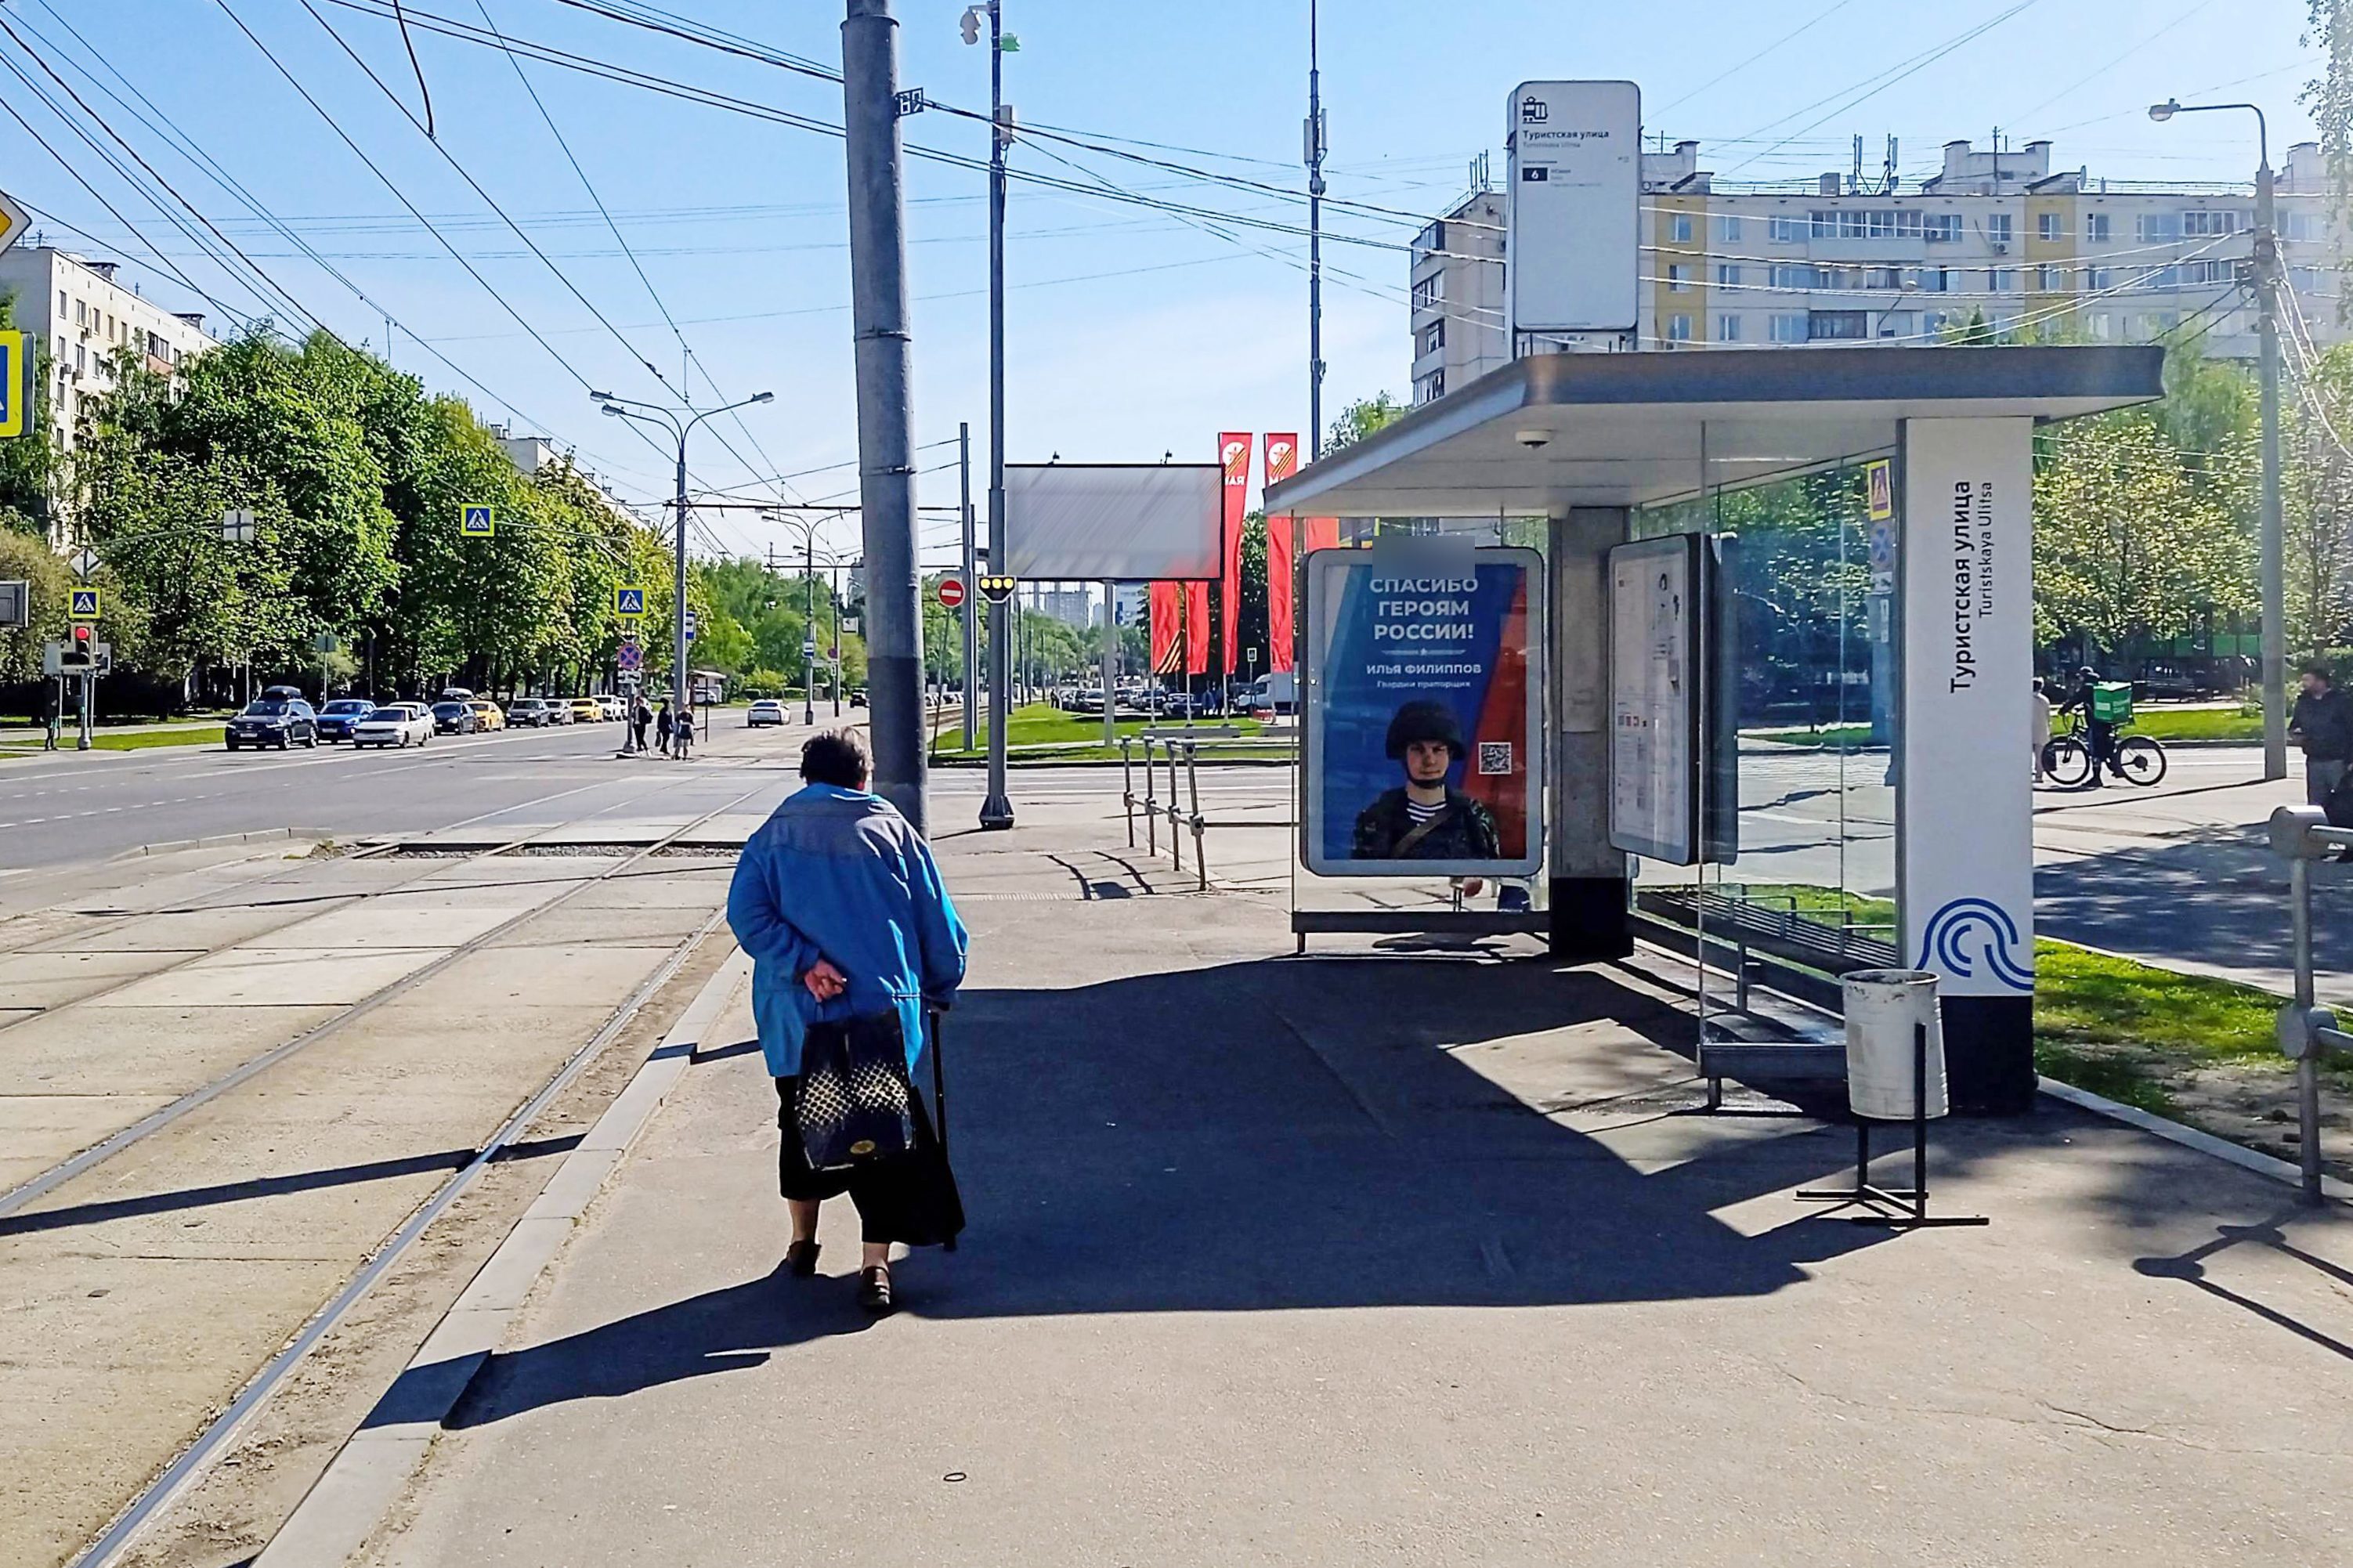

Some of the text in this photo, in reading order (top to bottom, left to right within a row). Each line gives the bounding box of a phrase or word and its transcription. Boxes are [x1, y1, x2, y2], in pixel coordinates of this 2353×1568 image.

[1523, 130, 1610, 140] Туристская улица
[1531, 170, 1539, 179] 6
[1978, 482, 1994, 618] Turistskaya Ulitsa
[1369, 578, 1479, 593] СПАСИБО
[1950, 481, 1975, 693] Туристская улица
[1379, 601, 1469, 616] ГЕРОЯМ
[1375, 624, 1474, 640] РОССИИ!
[1366, 664, 1482, 674] ИЛЬЯ ФИЛИППОВ
